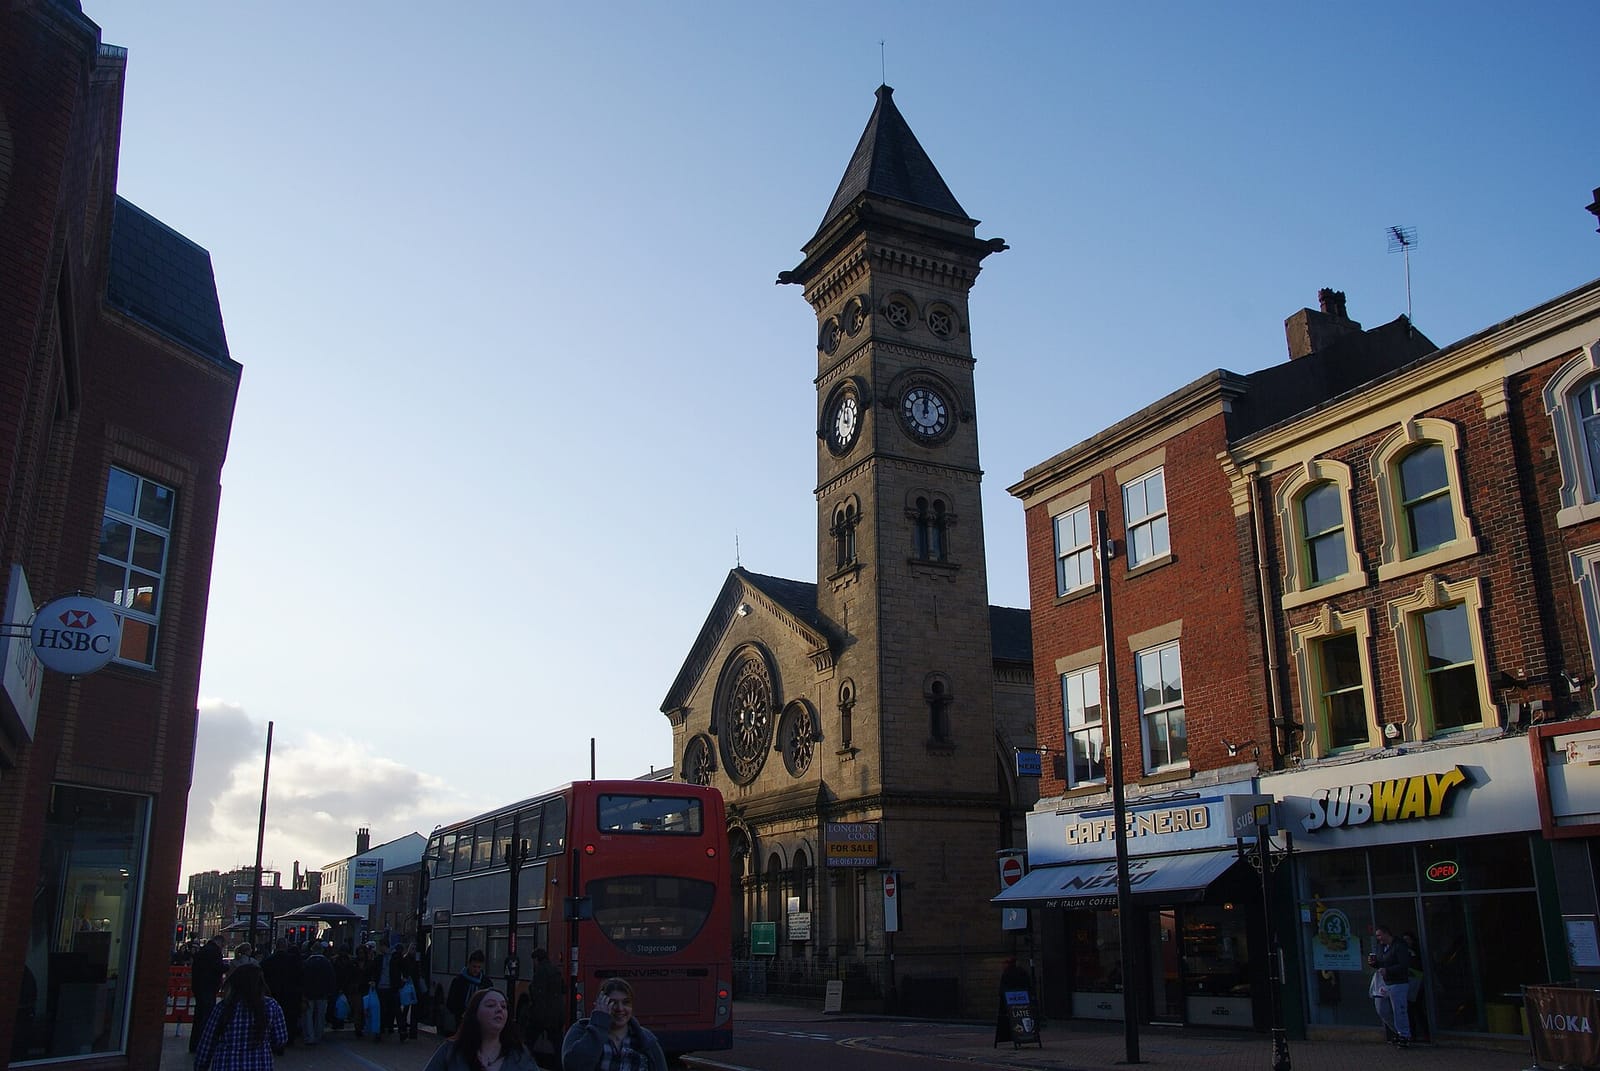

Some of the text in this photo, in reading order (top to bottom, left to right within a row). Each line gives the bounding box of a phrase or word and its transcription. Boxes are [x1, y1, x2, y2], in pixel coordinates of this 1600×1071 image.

[37, 628, 111, 654] HSBC
[1300, 765, 1465, 833] SUBWAY
[1138, 806, 1209, 836] NERO
[828, 823, 875, 832] LONGDN
[848, 832, 875, 840] COOK
[831, 844, 873, 852] FOR SALE
[1430, 865, 1455, 878] OPEN
[1061, 899, 1085, 907] ITALIAN
[1089, 897, 1117, 906] COFFEE
[637, 944, 677, 954] Stagecoach
[1011, 1008, 1031, 1017] LATTE
[1539, 1013, 1593, 1033] MOKA
